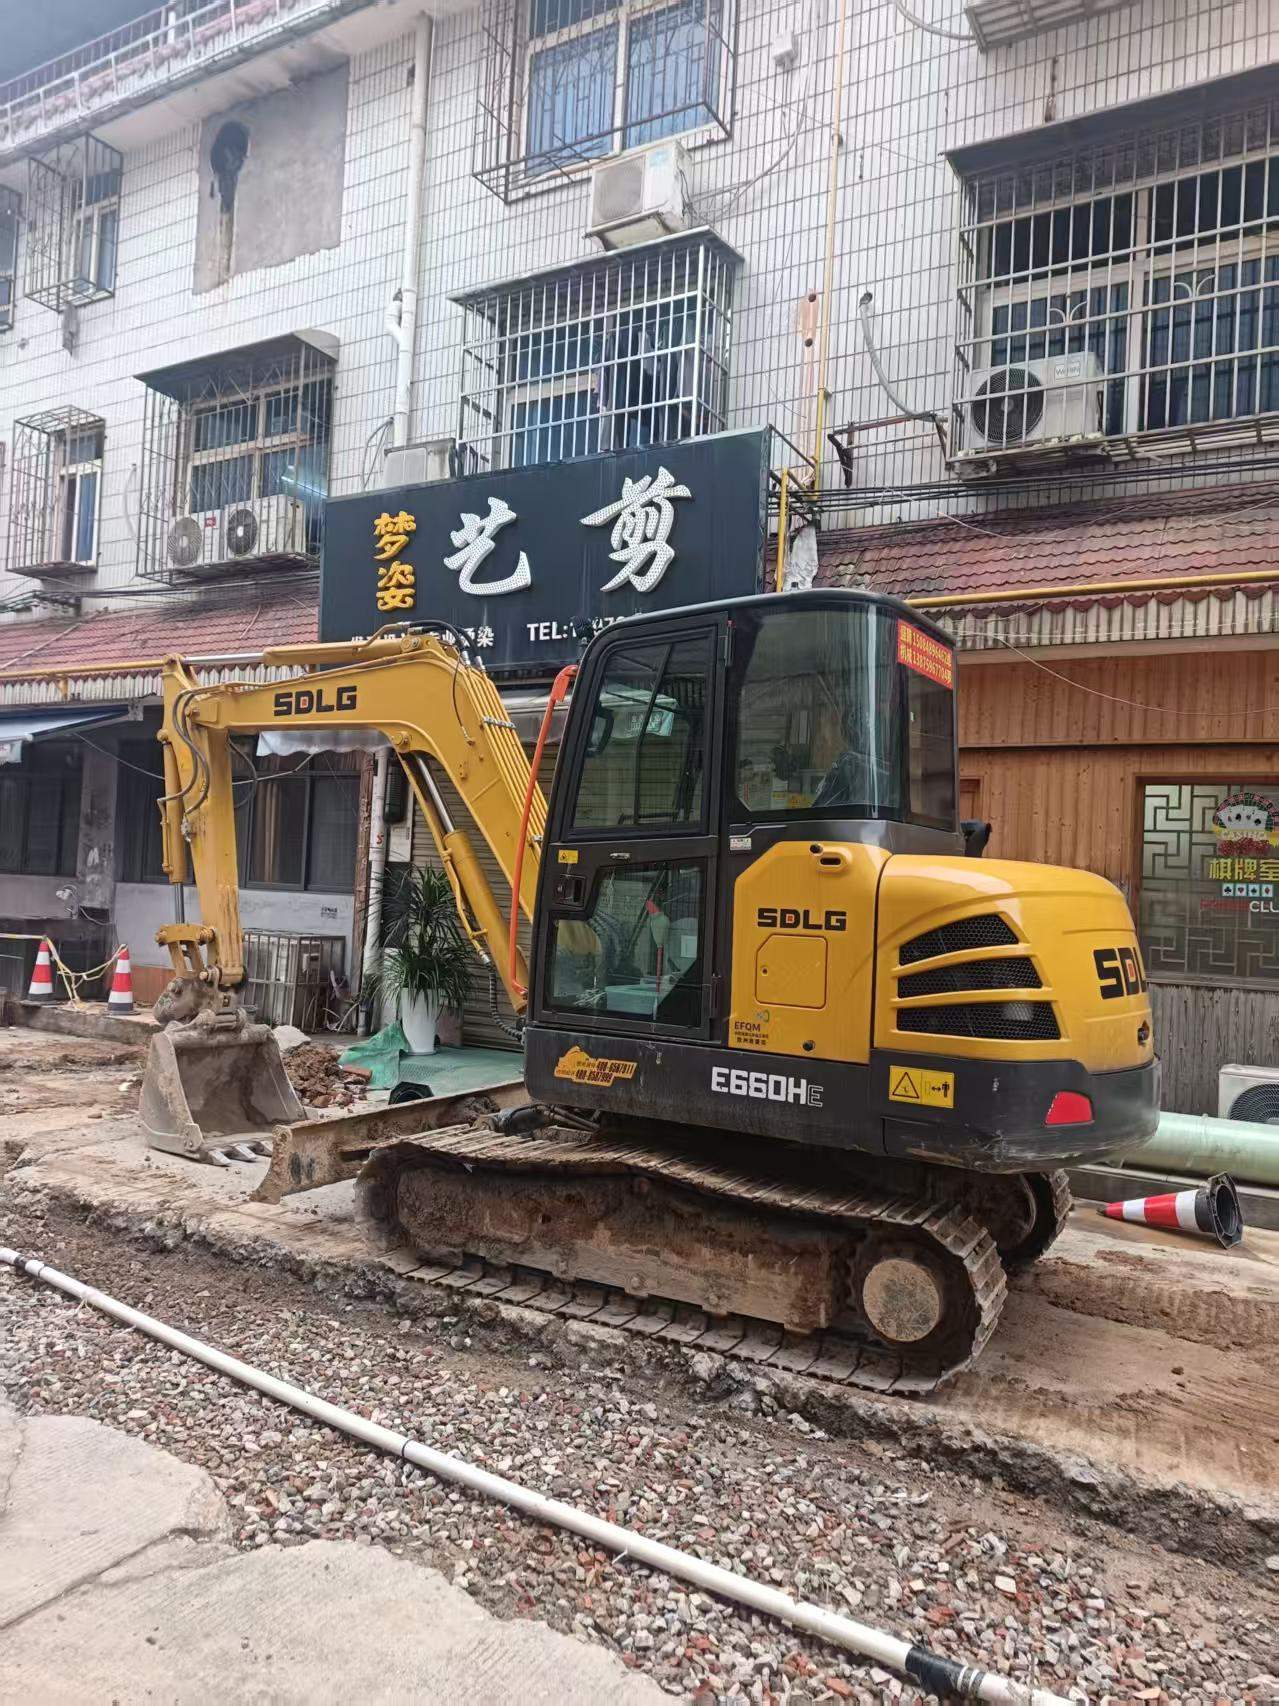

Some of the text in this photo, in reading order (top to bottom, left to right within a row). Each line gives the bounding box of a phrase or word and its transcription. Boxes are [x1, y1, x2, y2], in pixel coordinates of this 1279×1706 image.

[373, 511, 417, 613] 梦姿
[274, 685, 357, 716] SDLG
[1209, 858, 1279, 881] 棋牌室
[757, 907, 847, 932] SDLG
[734, 1021, 761, 1032] EFQM
[711, 1066, 824, 1107] E660HE
